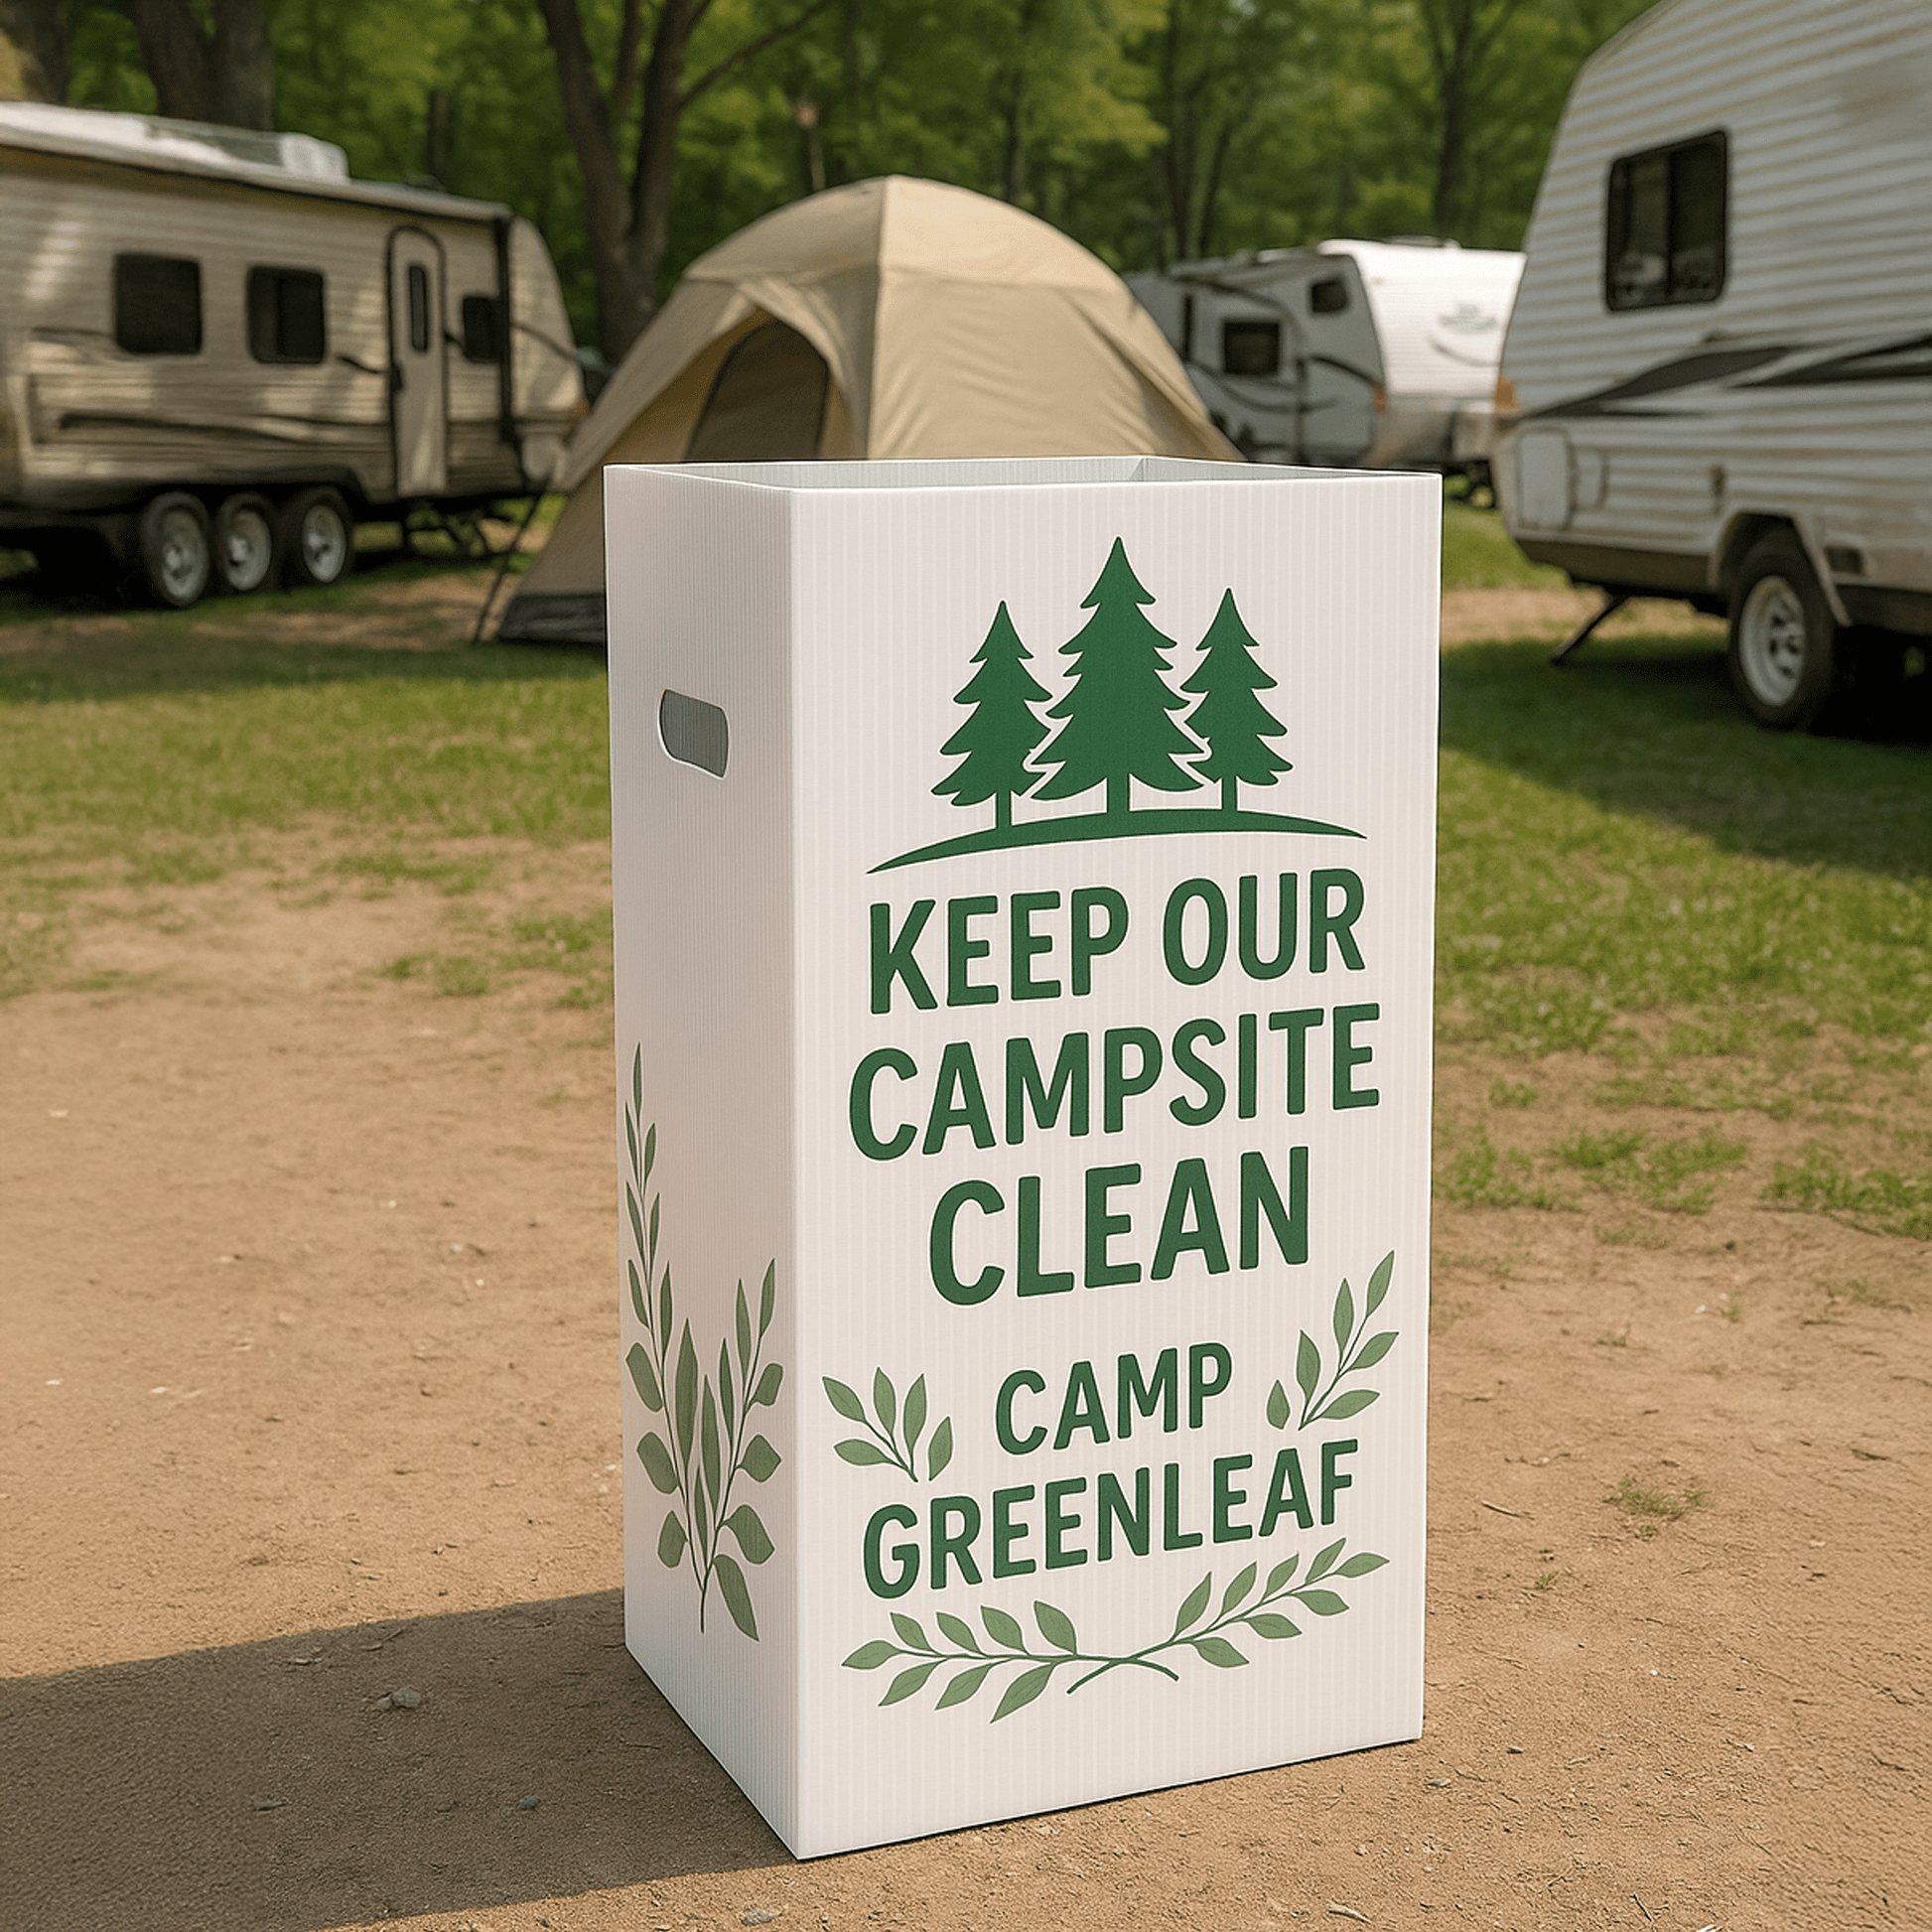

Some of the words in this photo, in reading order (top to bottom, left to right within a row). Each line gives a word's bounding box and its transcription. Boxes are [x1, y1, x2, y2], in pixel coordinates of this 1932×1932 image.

[870, 886, 1129, 1015] KEEP
[1163, 868, 1366, 986] OUR
[849, 1002, 1380, 1162] CAMPSITE
[929, 1146, 1310, 1306] CLEAN
[995, 1342, 1232, 1455] CAMP
[864, 1439, 1358, 1599] GREENLEAF
